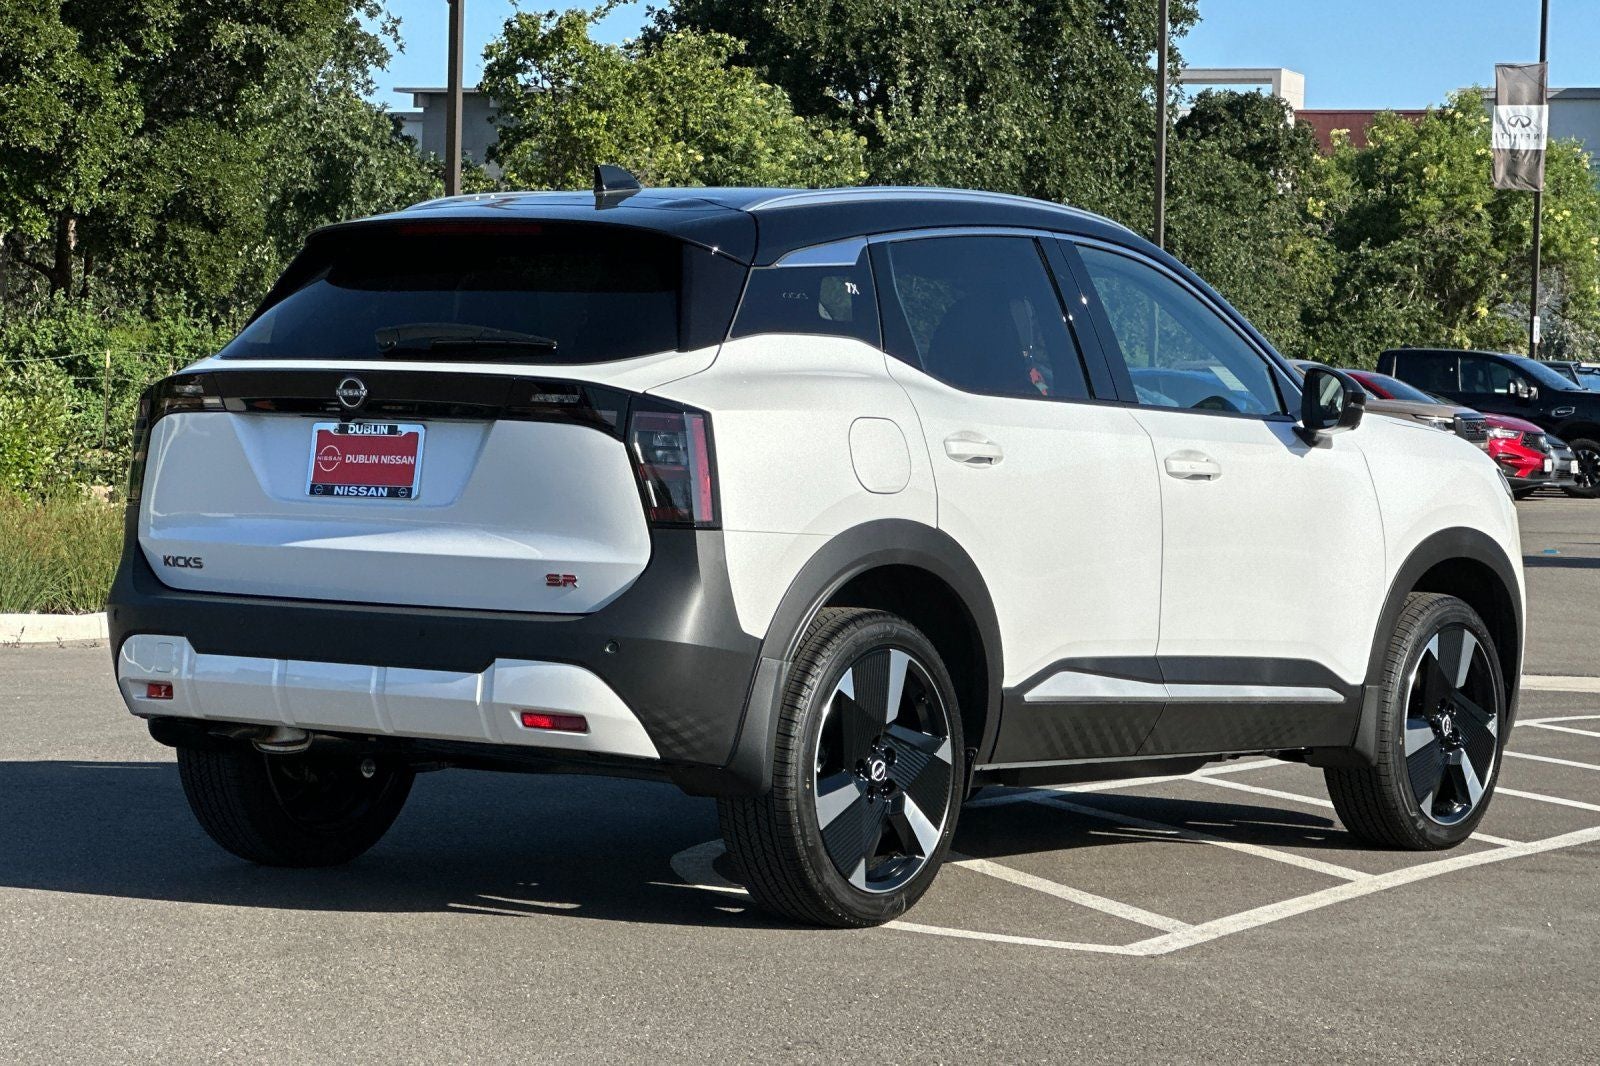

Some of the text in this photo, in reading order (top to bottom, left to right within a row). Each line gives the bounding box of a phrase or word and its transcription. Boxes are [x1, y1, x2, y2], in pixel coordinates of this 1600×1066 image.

[348, 425, 388, 434] DUBLIN
[345, 454, 415, 465] DUBLIN NISSAN
[334, 486, 388, 496] NISSAN
[163, 554, 204, 569] KICKS
[545, 573, 579, 588] SR
